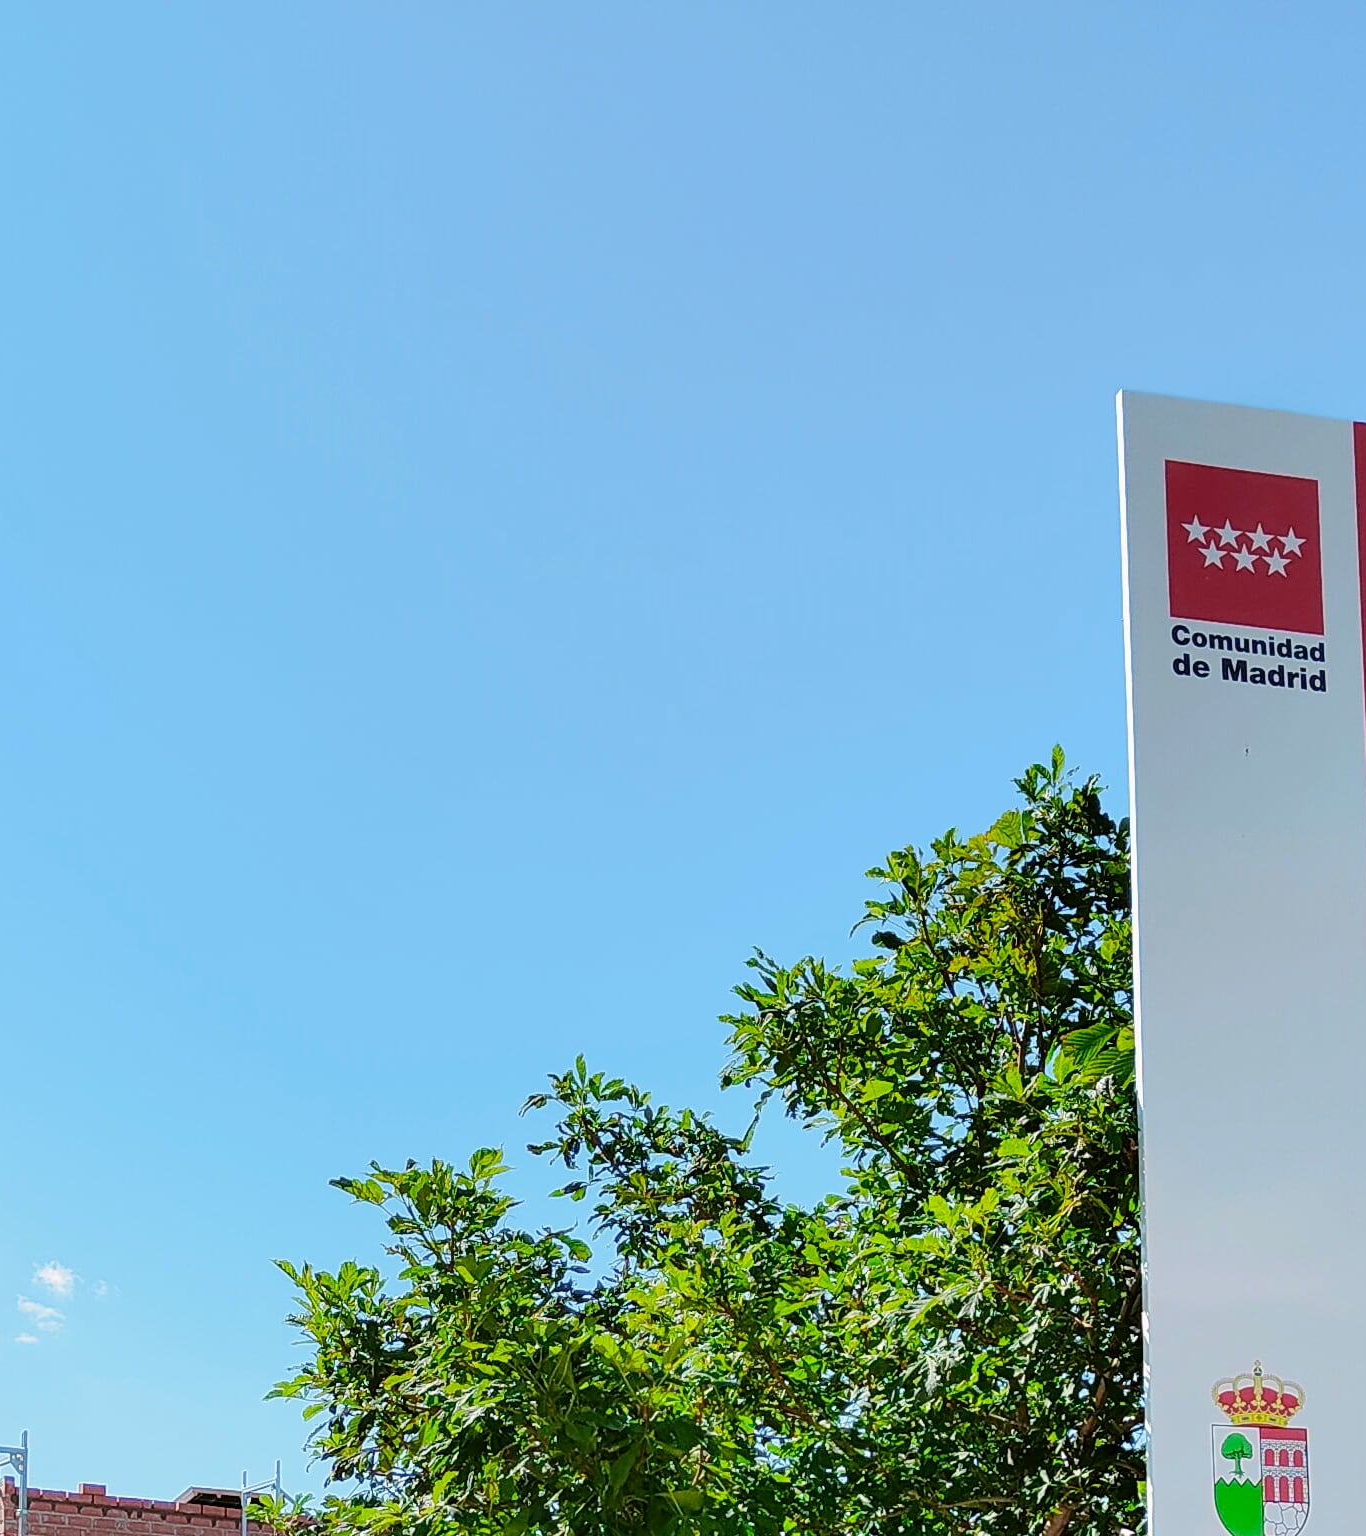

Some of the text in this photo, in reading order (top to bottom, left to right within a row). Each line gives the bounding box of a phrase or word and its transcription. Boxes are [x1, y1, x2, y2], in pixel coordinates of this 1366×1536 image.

[1172, 625, 1325, 662] Comunidad
[1173, 653, 1326, 692] de Madrid
